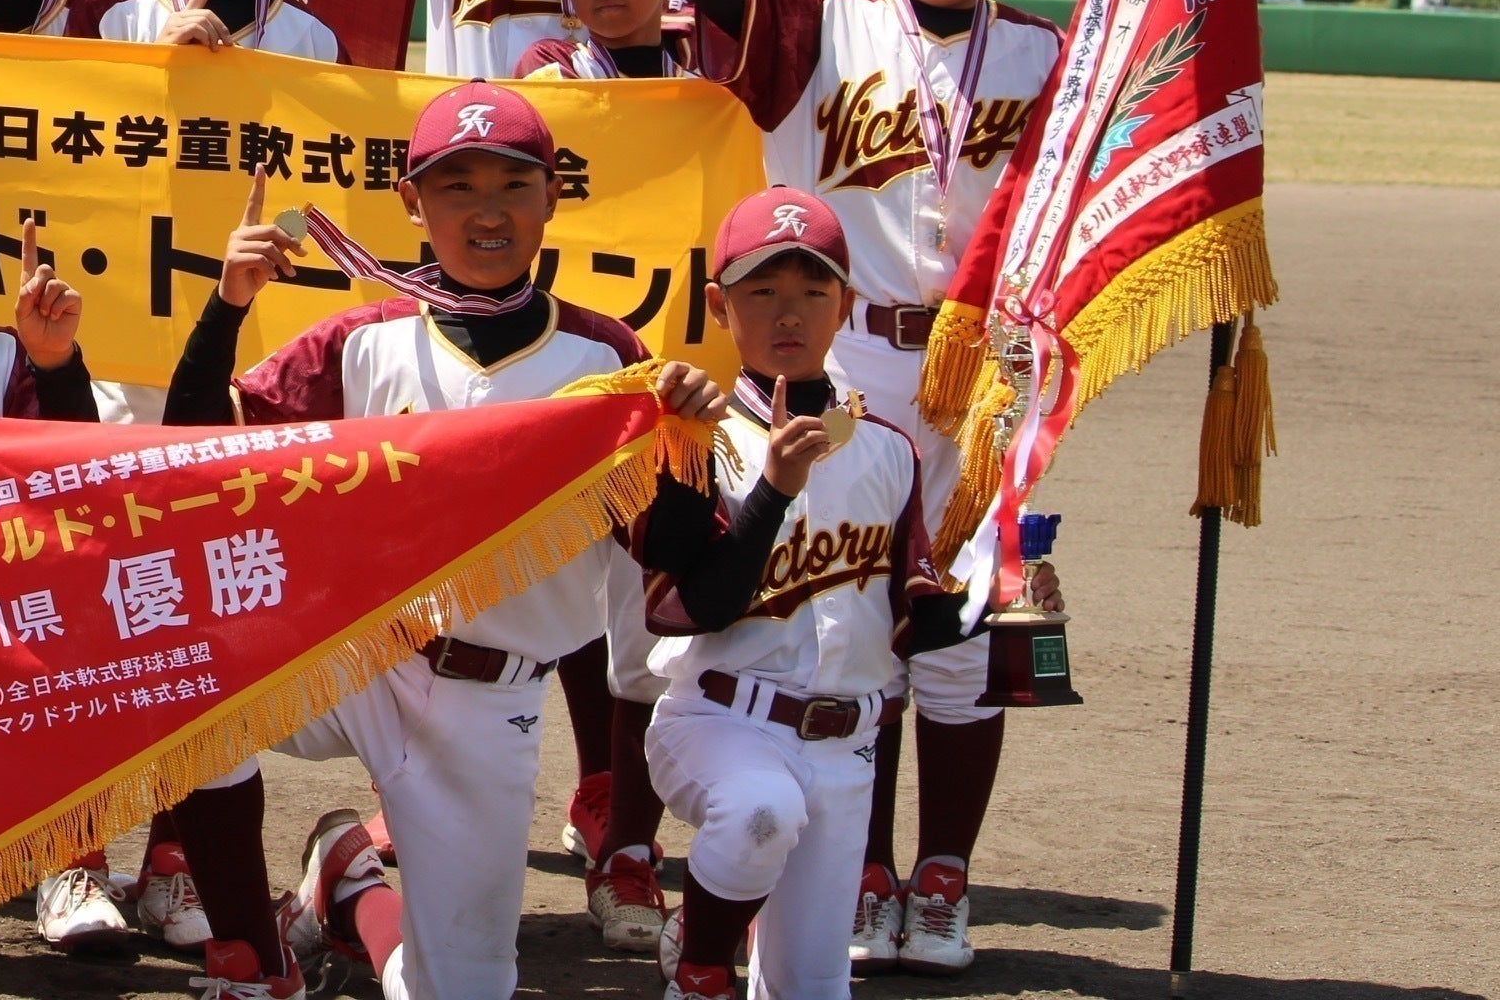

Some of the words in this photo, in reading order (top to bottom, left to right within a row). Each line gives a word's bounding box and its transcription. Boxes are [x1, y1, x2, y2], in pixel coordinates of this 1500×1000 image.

[24, 422, 334, 500] 全日本学童軟式野球大会
[101, 528, 288, 640] 優勝
